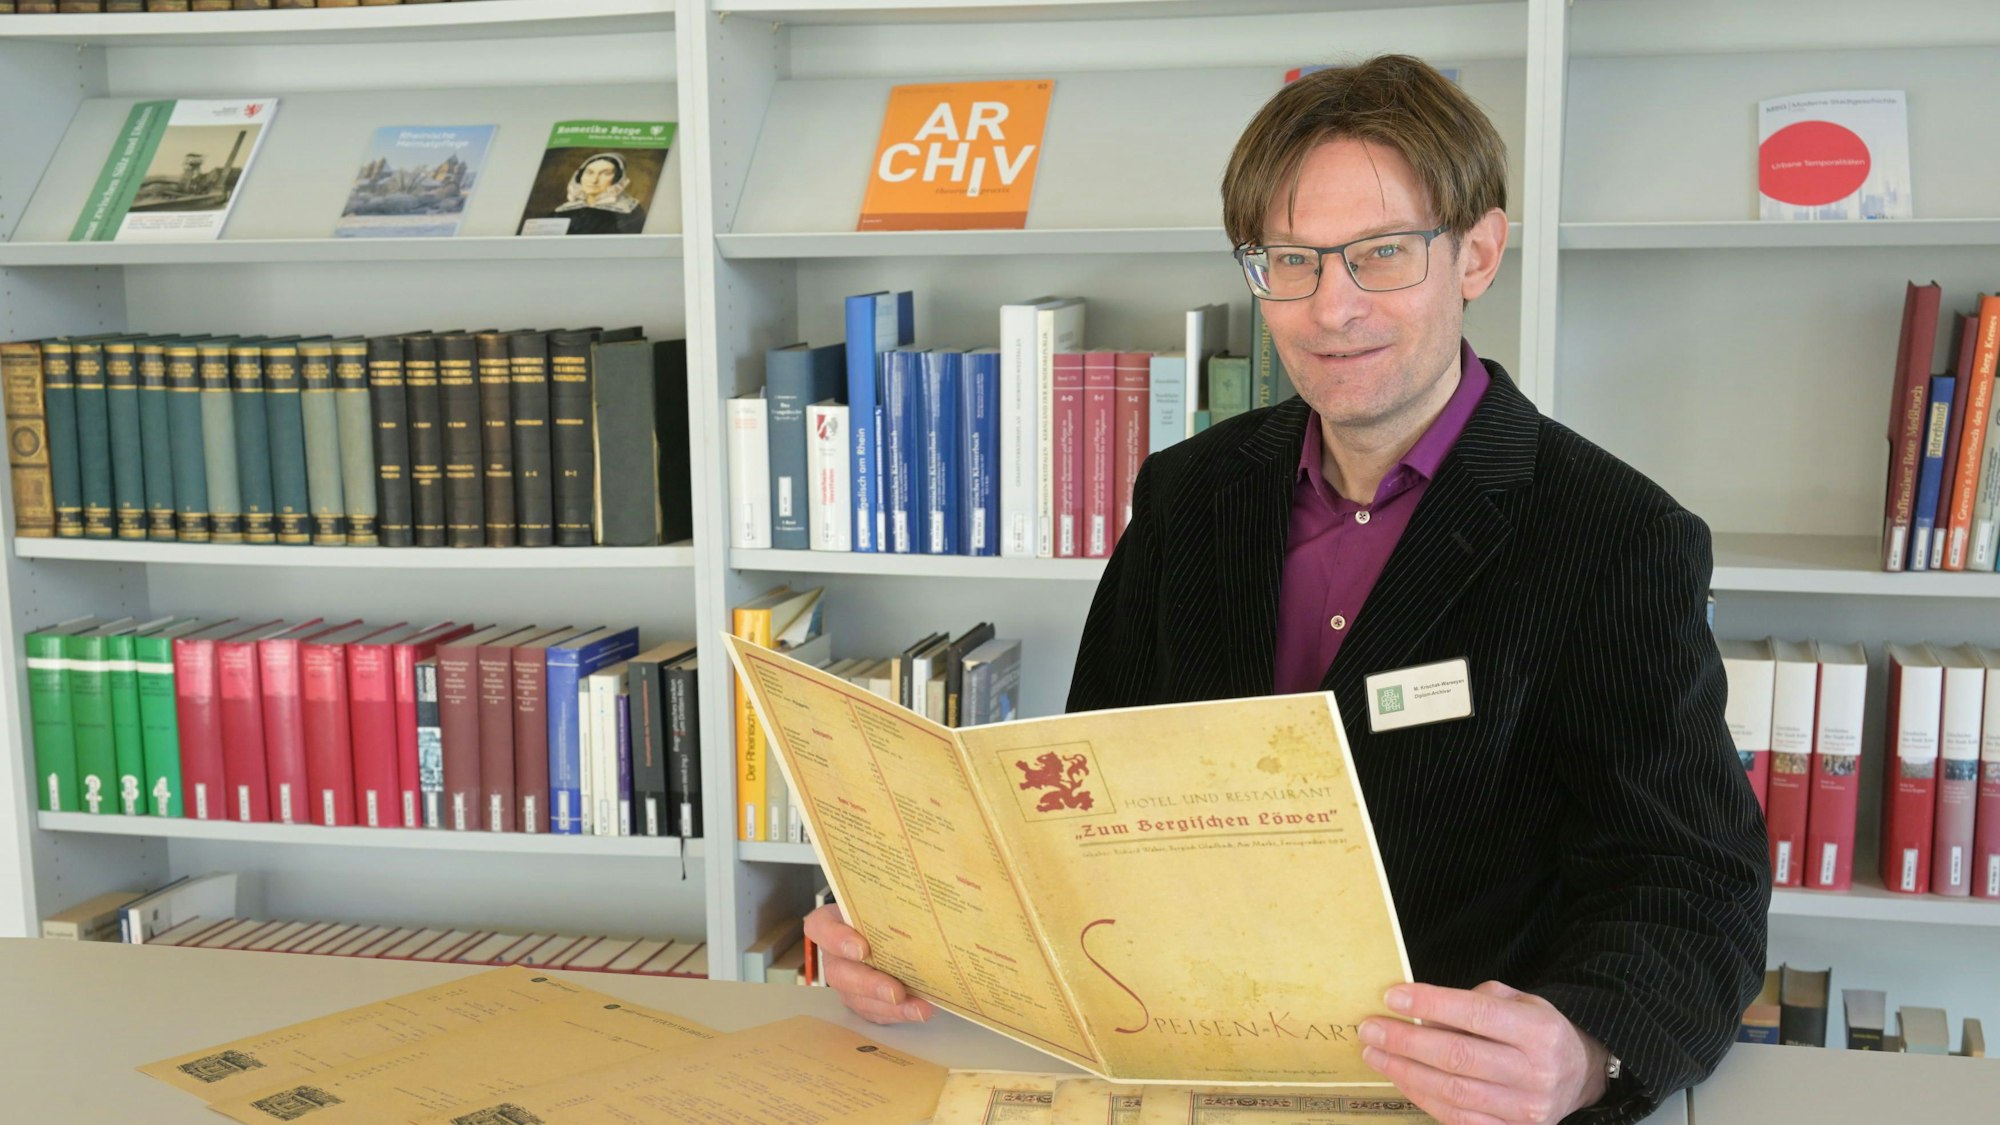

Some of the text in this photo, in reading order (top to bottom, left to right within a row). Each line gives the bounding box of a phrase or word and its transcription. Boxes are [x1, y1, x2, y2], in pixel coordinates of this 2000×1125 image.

[556, 124, 643, 137] Romerike Berge
[913, 101, 1010, 142] AR
[123, 138, 139, 157] und
[877, 142, 1038, 198] CHIV
[1771, 158, 1866, 170] Urbane Temporalitäten
[1260, 384, 1270, 408] ATLA
[891, 430, 899, 475] Klosterbuch
[928, 432, 937, 476] Klosterbuch
[972, 432, 980, 477] Klosterbuch
[1902, 442, 1917, 468] Rote
[1964, 430, 1980, 477] Adreßbuch
[1972, 411, 1982, 427] des
[857, 428, 870, 510] gelisch am Rhein
[669, 679, 678, 703] Lexikon
[677, 678, 686, 697] Reich
[1414, 688, 1452, 699] Diplom-Archivar
[677, 698, 686, 720] Dritten
[745, 764, 756, 782] Der
[85, 774, 103, 802] 2
[121, 774, 139, 802] 3
[1124, 787, 1333, 809] HOTEL UND RESTAURANT
[1080, 918, 1362, 1041] SPEISEN-KART
